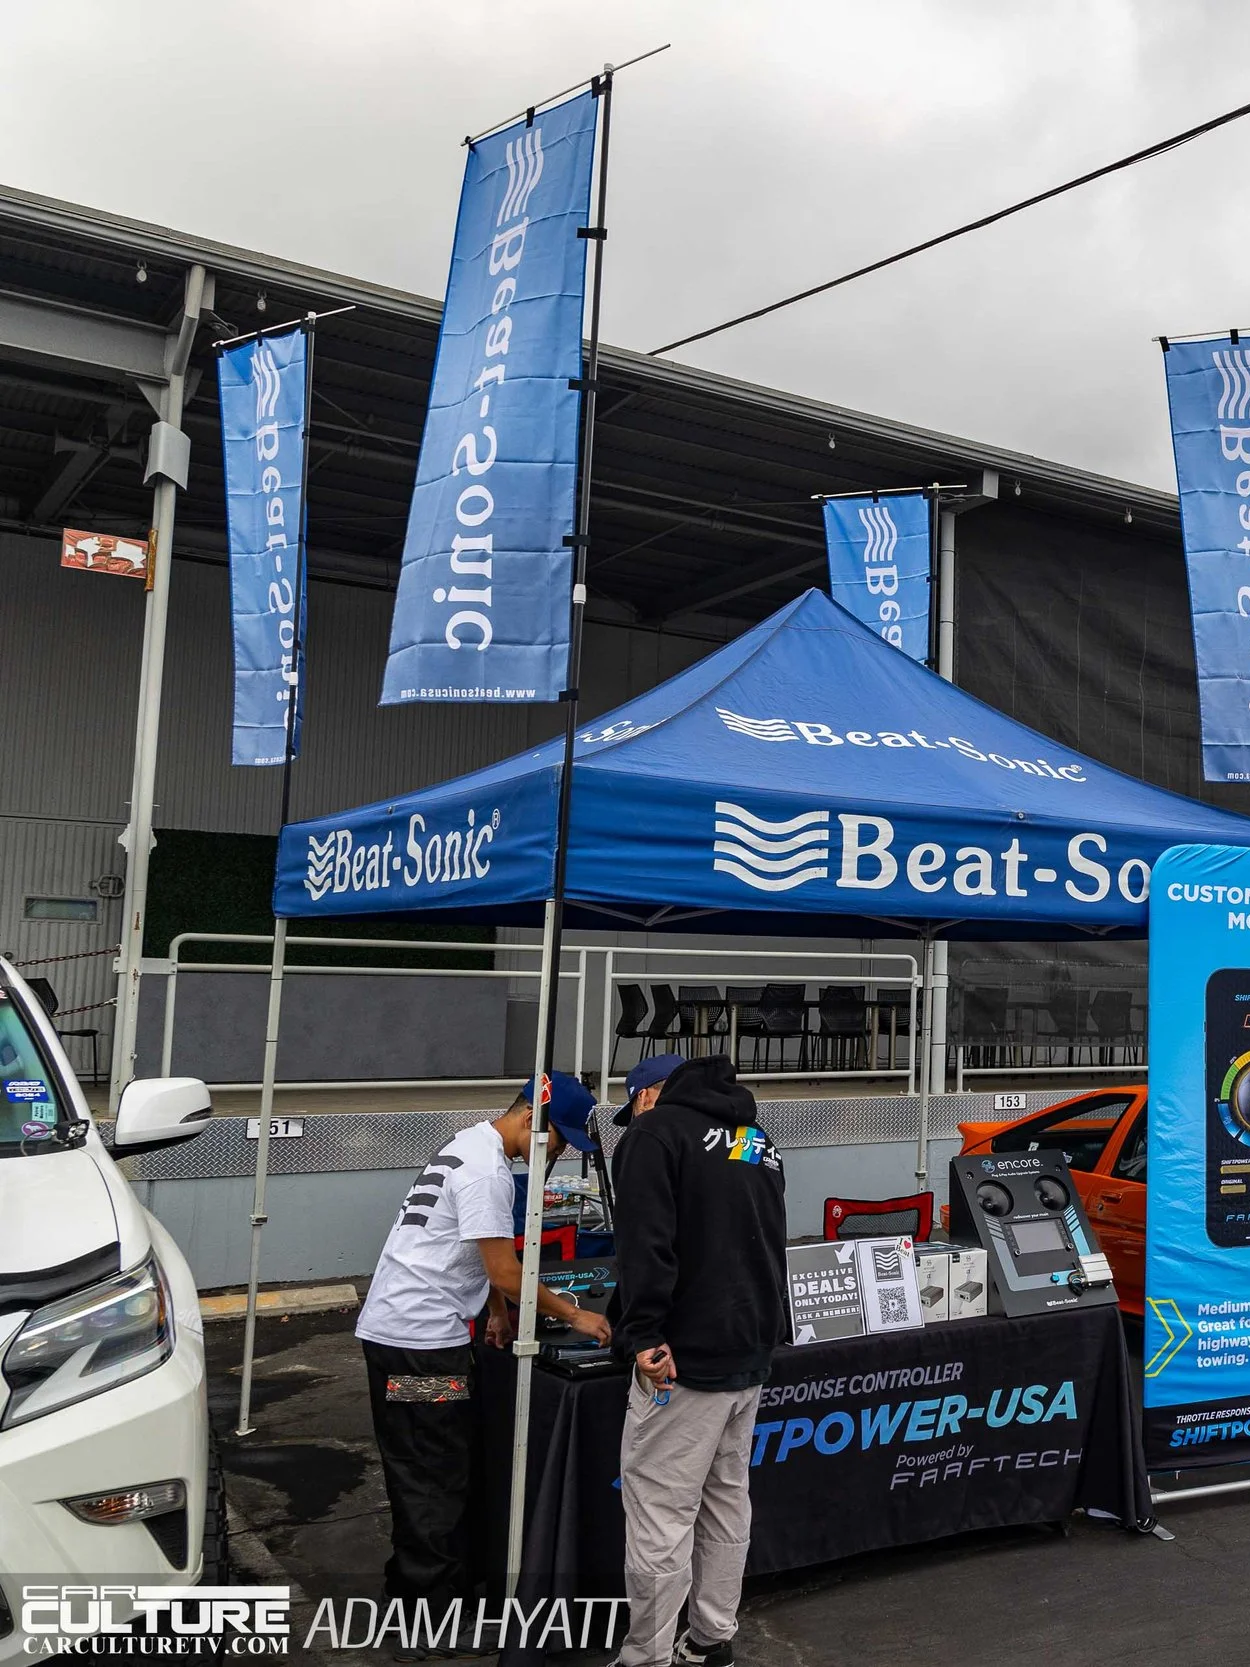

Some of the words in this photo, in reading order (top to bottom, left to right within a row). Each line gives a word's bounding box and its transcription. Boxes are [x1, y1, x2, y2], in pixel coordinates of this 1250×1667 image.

[1000, 1096, 1020, 1107] 153
[792, 1267, 853, 1281] EXCLUSIVE
[793, 1276, 857, 1297] DEALS
[794, 1297, 821, 1308] ONLY
[822, 1292, 858, 1304] TODAY!
[796, 1312, 813, 1320] ASK
[1197, 1319, 1236, 1334] Great
[1197, 1352, 1249, 1368] towing.
[848, 1361, 965, 1395] CONTROLLER
[1176, 1410, 1217, 1424] THROTTLE
[895, 1446, 954, 1468] Powered
[956, 1443, 974, 1458] by
